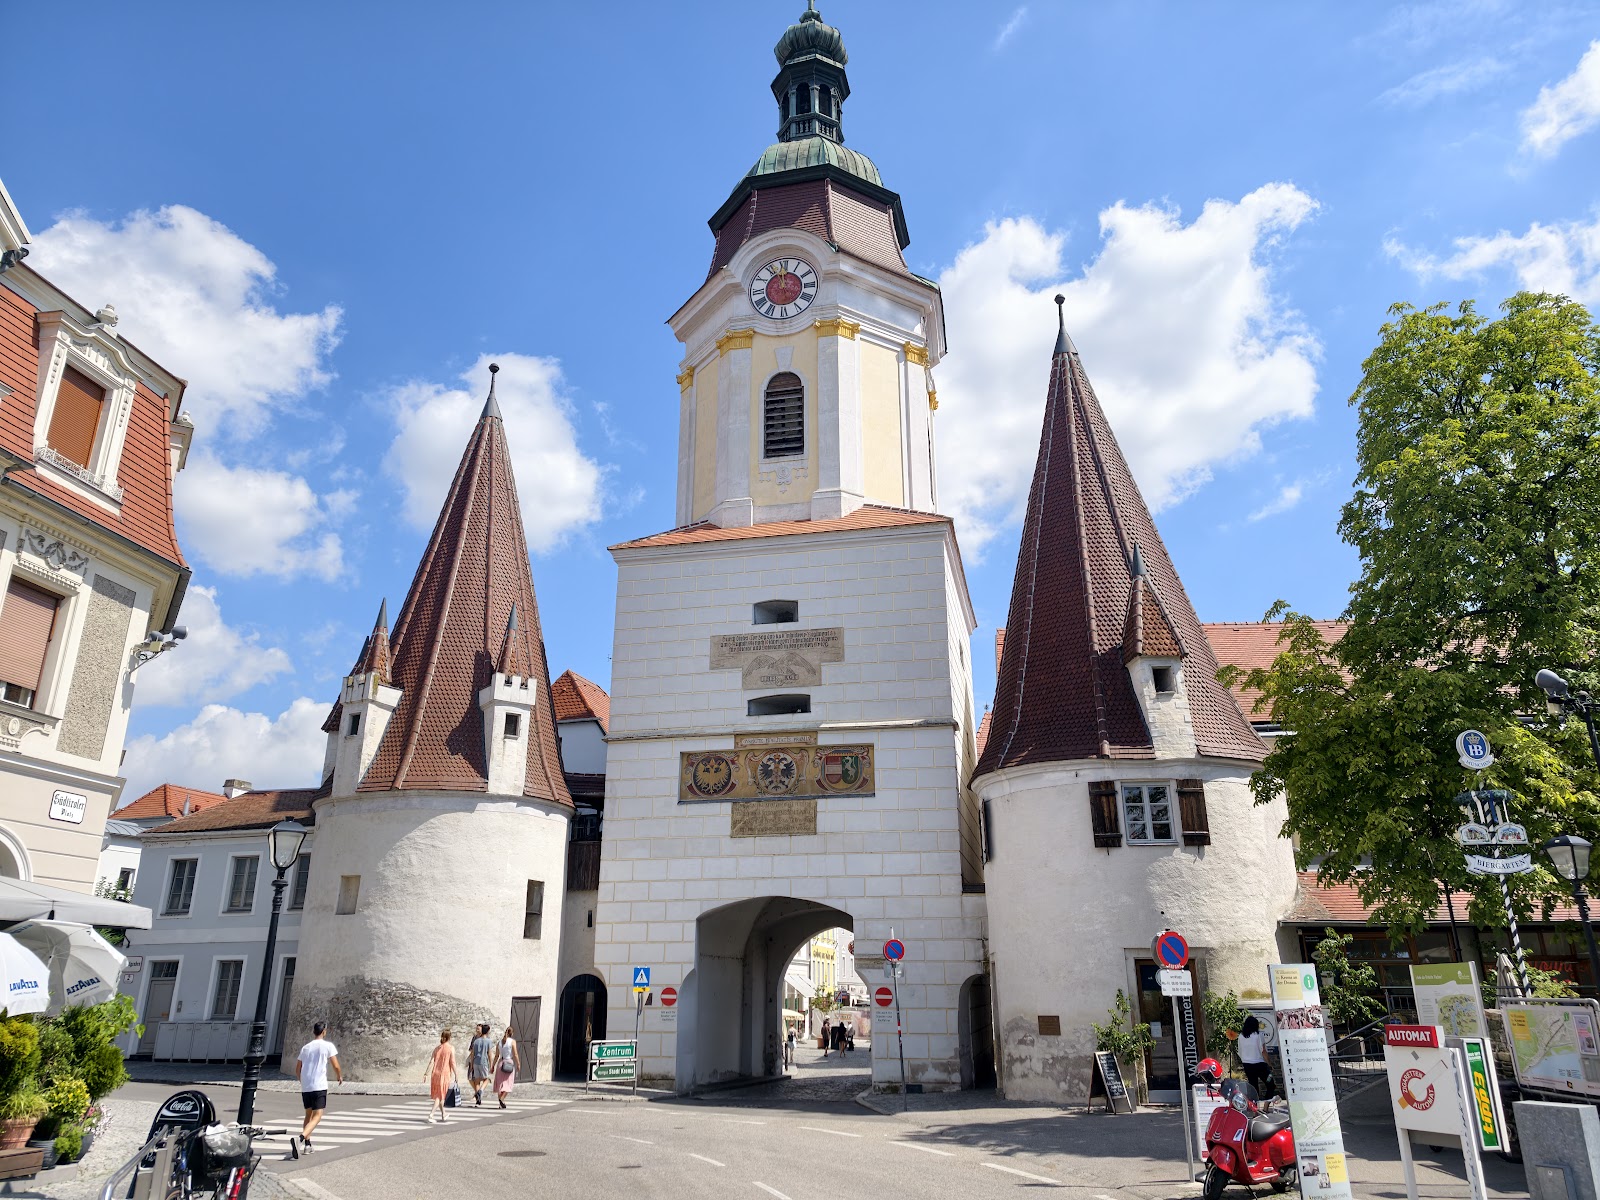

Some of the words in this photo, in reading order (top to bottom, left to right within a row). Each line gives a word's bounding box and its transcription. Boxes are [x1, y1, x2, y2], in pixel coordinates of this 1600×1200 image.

[1468, 744, 1484, 756] HB
[54, 794, 84, 810] Südtiroler
[1477, 858, 1526, 870] BIERGARTEN
[10, 979, 39, 991] LAVAZZA
[1182, 996, 1198, 1078] Willkommen
[1388, 1030, 1430, 1042] AUTOMAT
[602, 1048, 632, 1056] Zentrum
[1402, 1070, 1423, 1093] ZIGARETTEN
[1413, 1089, 1434, 1110] AUTOMAT
